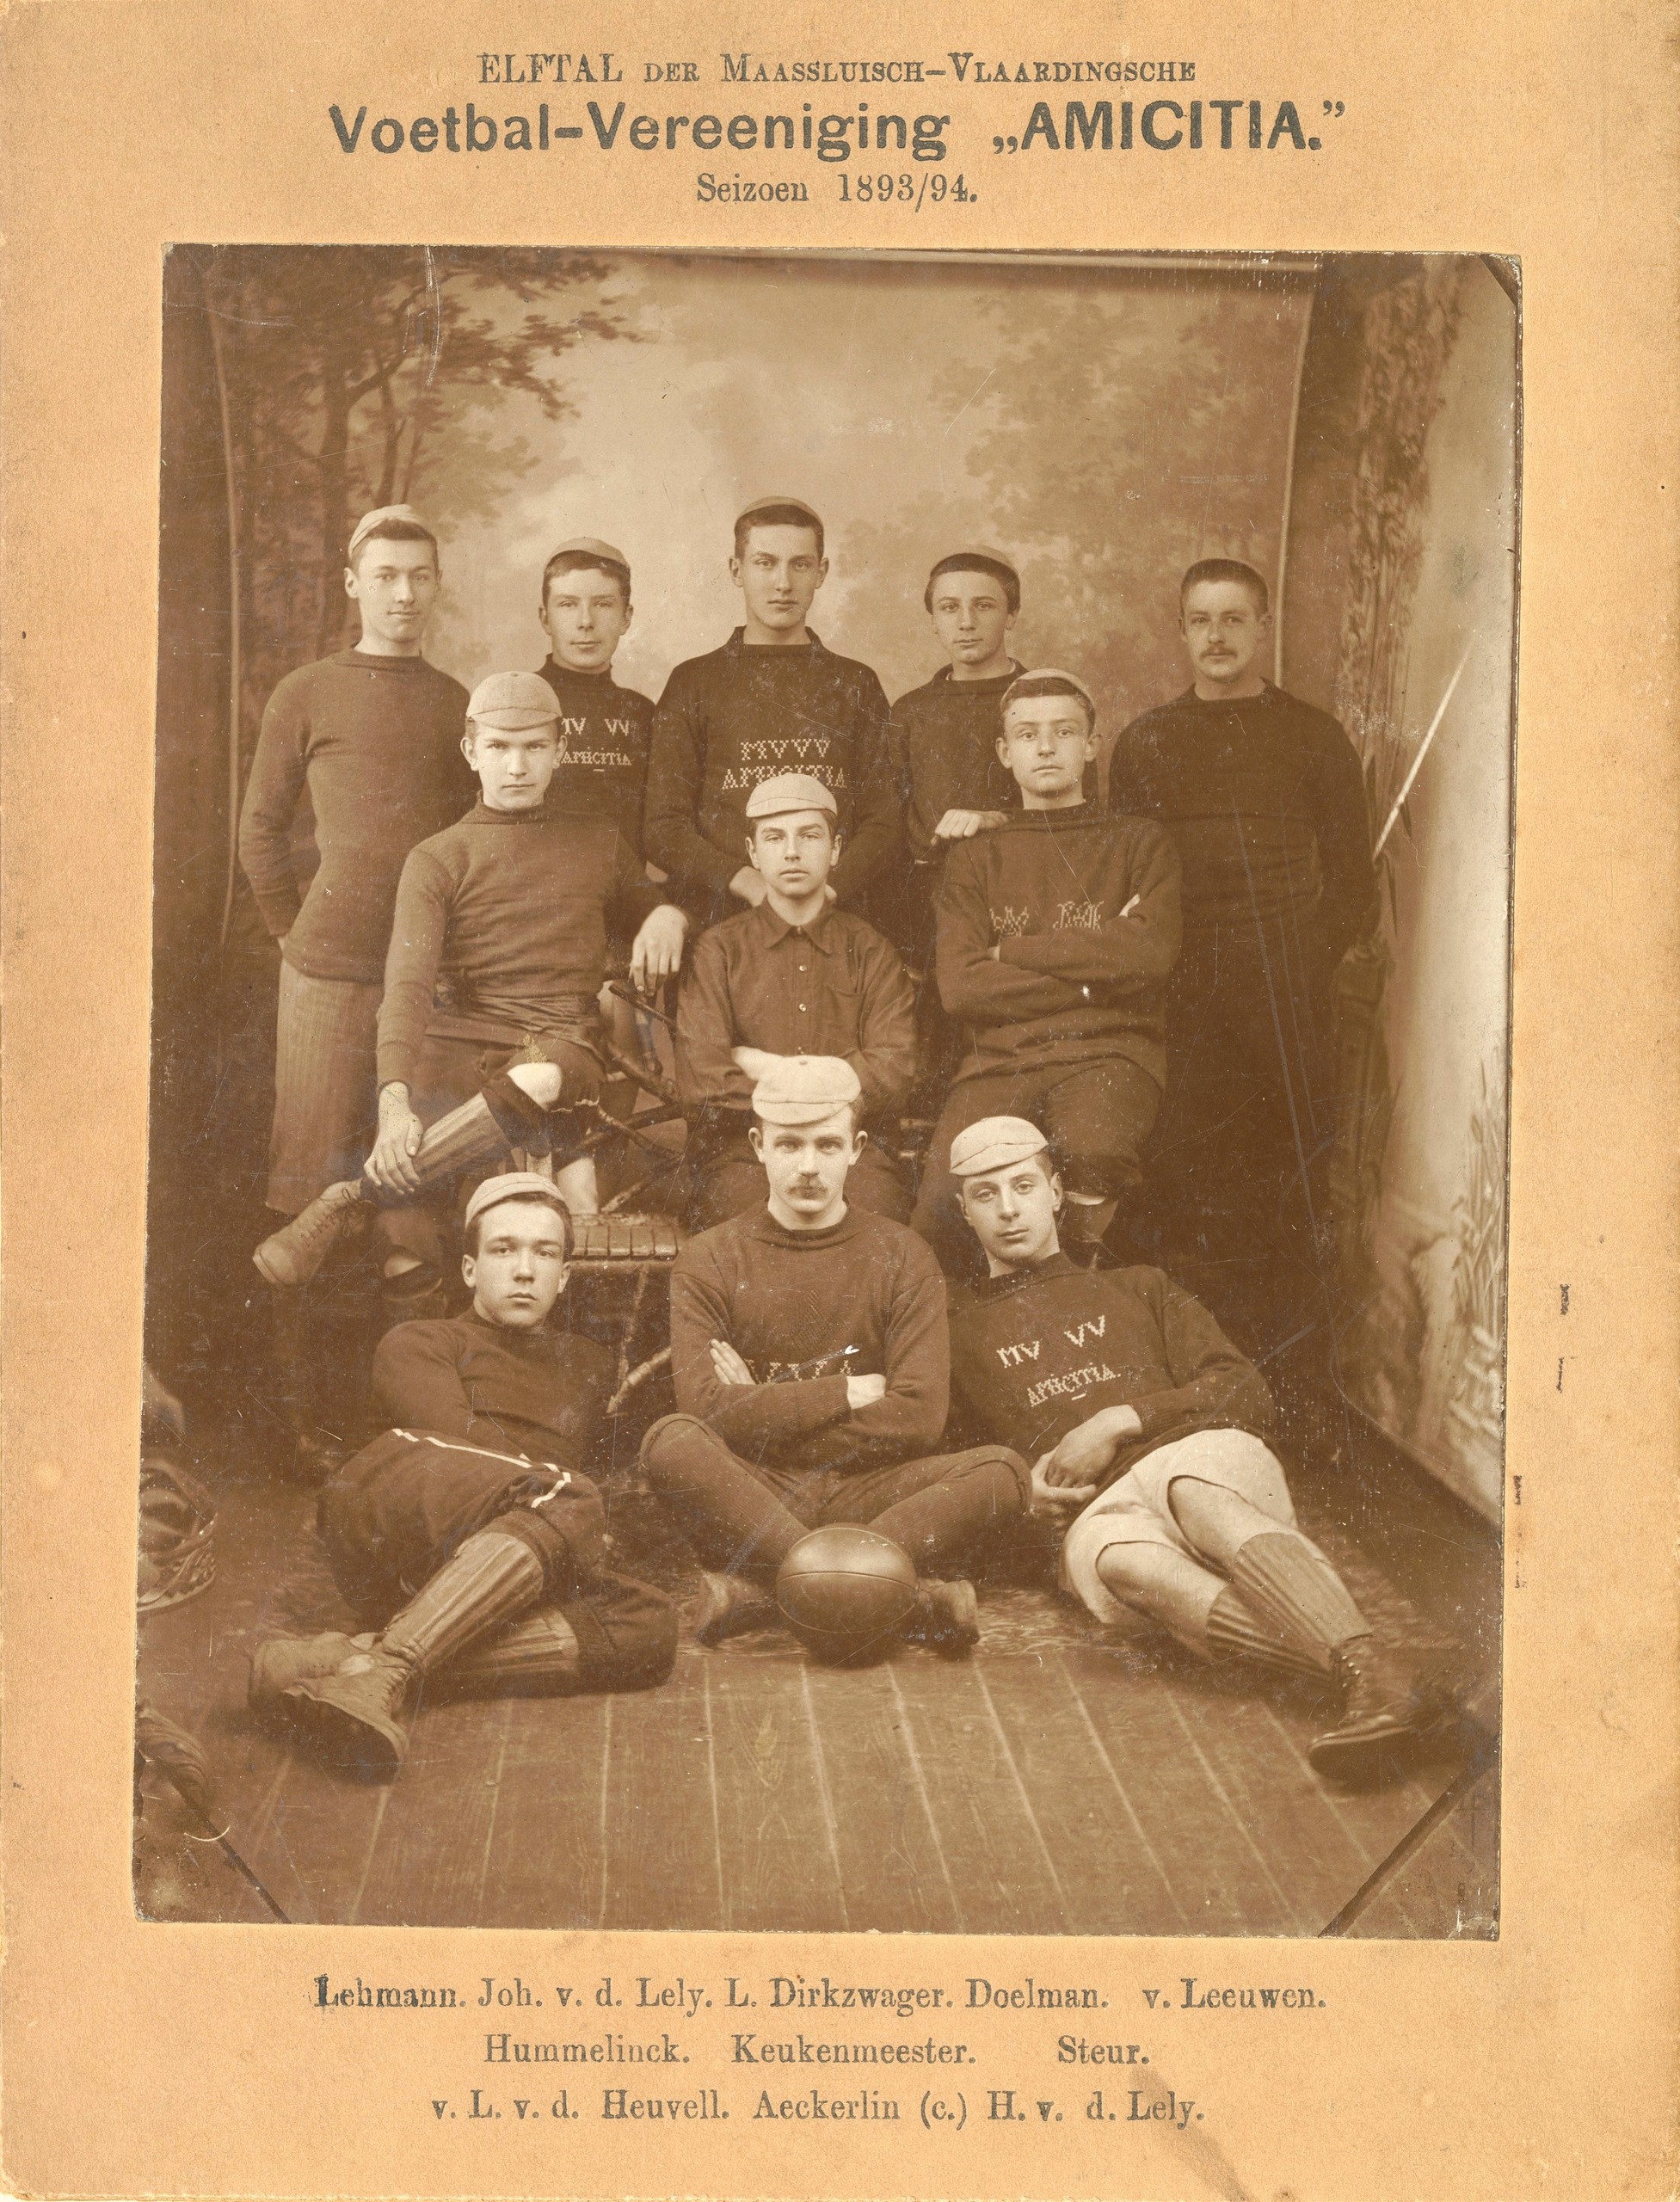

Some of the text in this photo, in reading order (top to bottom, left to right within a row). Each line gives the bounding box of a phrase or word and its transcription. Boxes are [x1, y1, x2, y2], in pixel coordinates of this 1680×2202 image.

[479, 52, 623, 83] ELFTAL
[328, 101, 951, 163] Voetbal-Vereeniging
[697, 172, 979, 213] Seizoen 1893/94.
[996, 1340, 1040, 1369] MV
[314, 1974, 1326, 2018] Lehmann. Joh. v. d. Lely. L. Dirkzwager. Doelman. v. Leeuwen.
[484, 2033, 1150, 2064] Hummelinck. Keukenmeester. Steur.
[432, 2089, 1204, 2131] v. L. v. d. Heuvell. Aeckerlin (c.) H. v. d. Lely.
